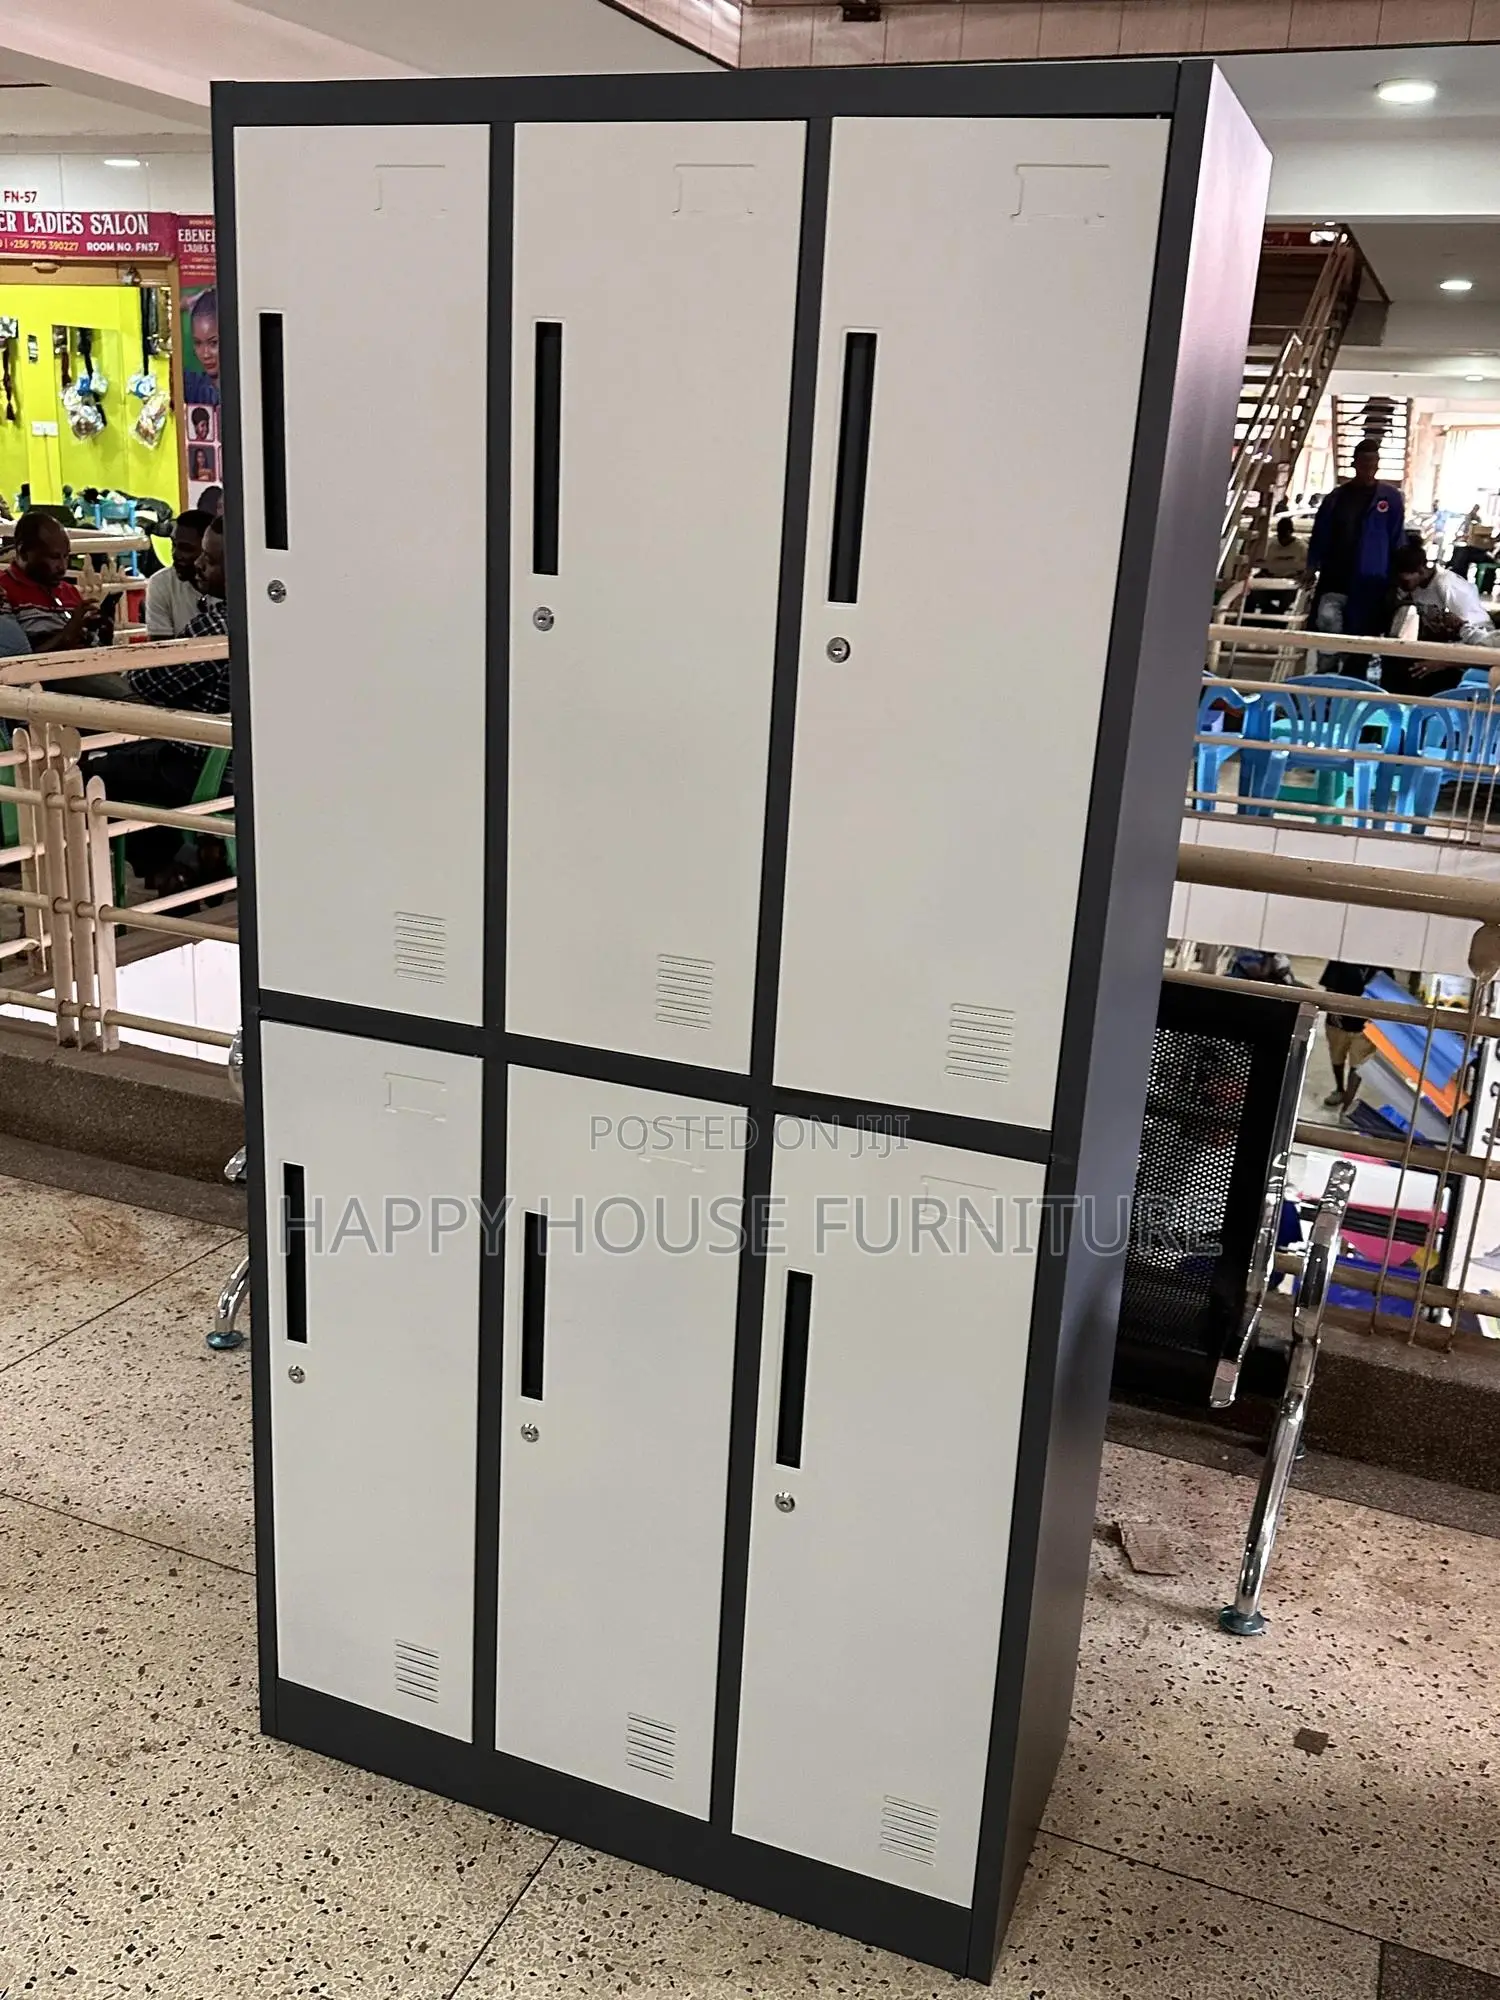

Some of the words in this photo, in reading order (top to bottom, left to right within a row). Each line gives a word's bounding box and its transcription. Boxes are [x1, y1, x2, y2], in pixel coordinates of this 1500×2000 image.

[4, 191, 37, 203] FN-57
[23, 211, 84, 234] LADIES
[89, 213, 149, 235] SALON
[86, 242, 115, 252] ROOM
[135, 242, 160, 252] FN57
